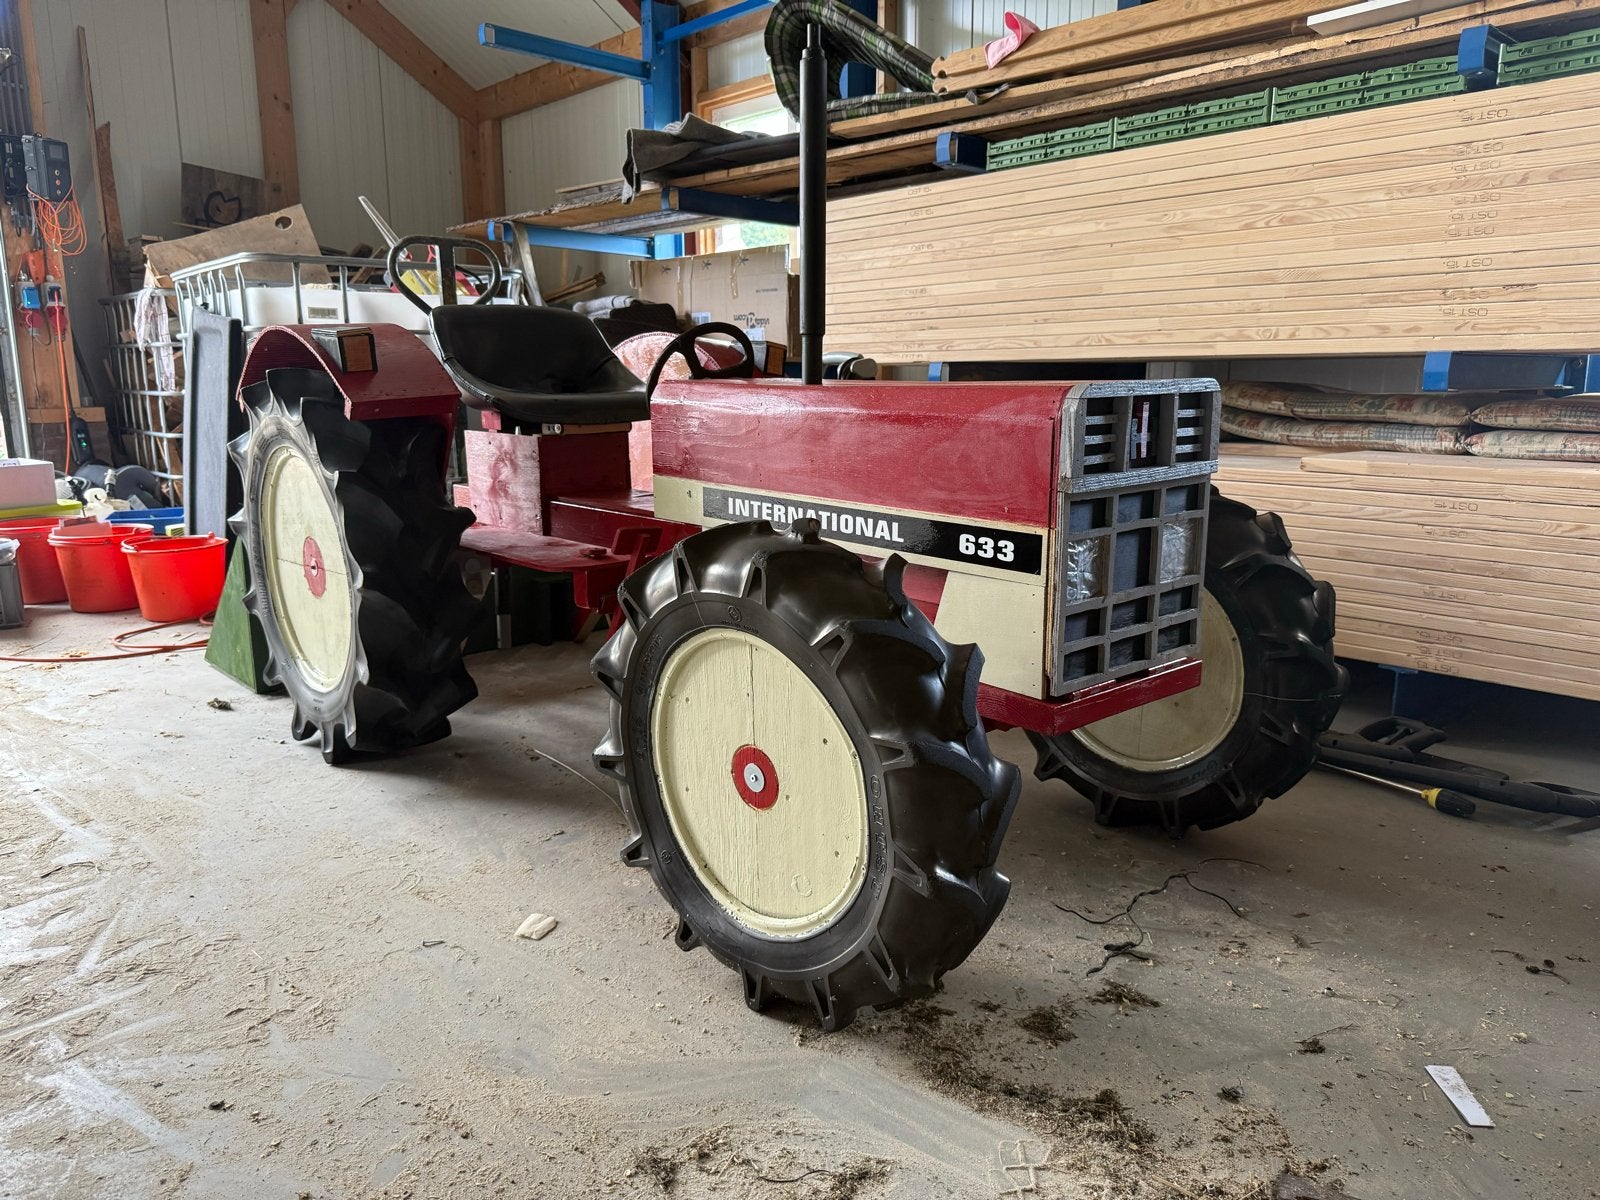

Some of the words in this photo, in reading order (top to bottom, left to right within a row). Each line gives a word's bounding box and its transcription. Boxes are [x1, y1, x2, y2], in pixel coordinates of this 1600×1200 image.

[1463, 258, 1493, 268] OST
[1460, 308, 1488, 317] OST
[1449, 502, 1479, 511] OST
[959, 533, 1015, 562] 633
